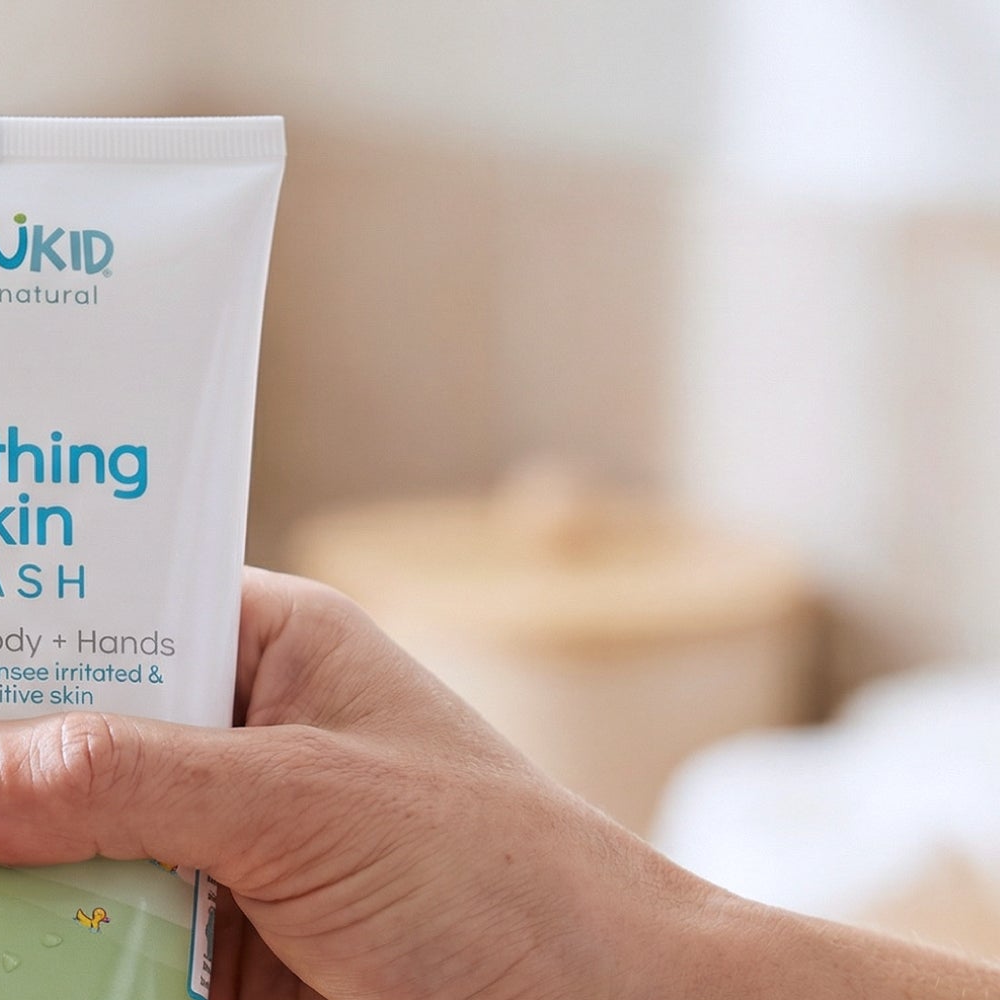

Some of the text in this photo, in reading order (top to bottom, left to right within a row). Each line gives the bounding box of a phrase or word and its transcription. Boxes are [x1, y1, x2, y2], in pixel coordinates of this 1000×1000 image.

[77, 630, 176, 657] Hands
[55, 662, 142, 683] irritated
[148, 666, 164, 684] &
[49, 685, 94, 705] skin
